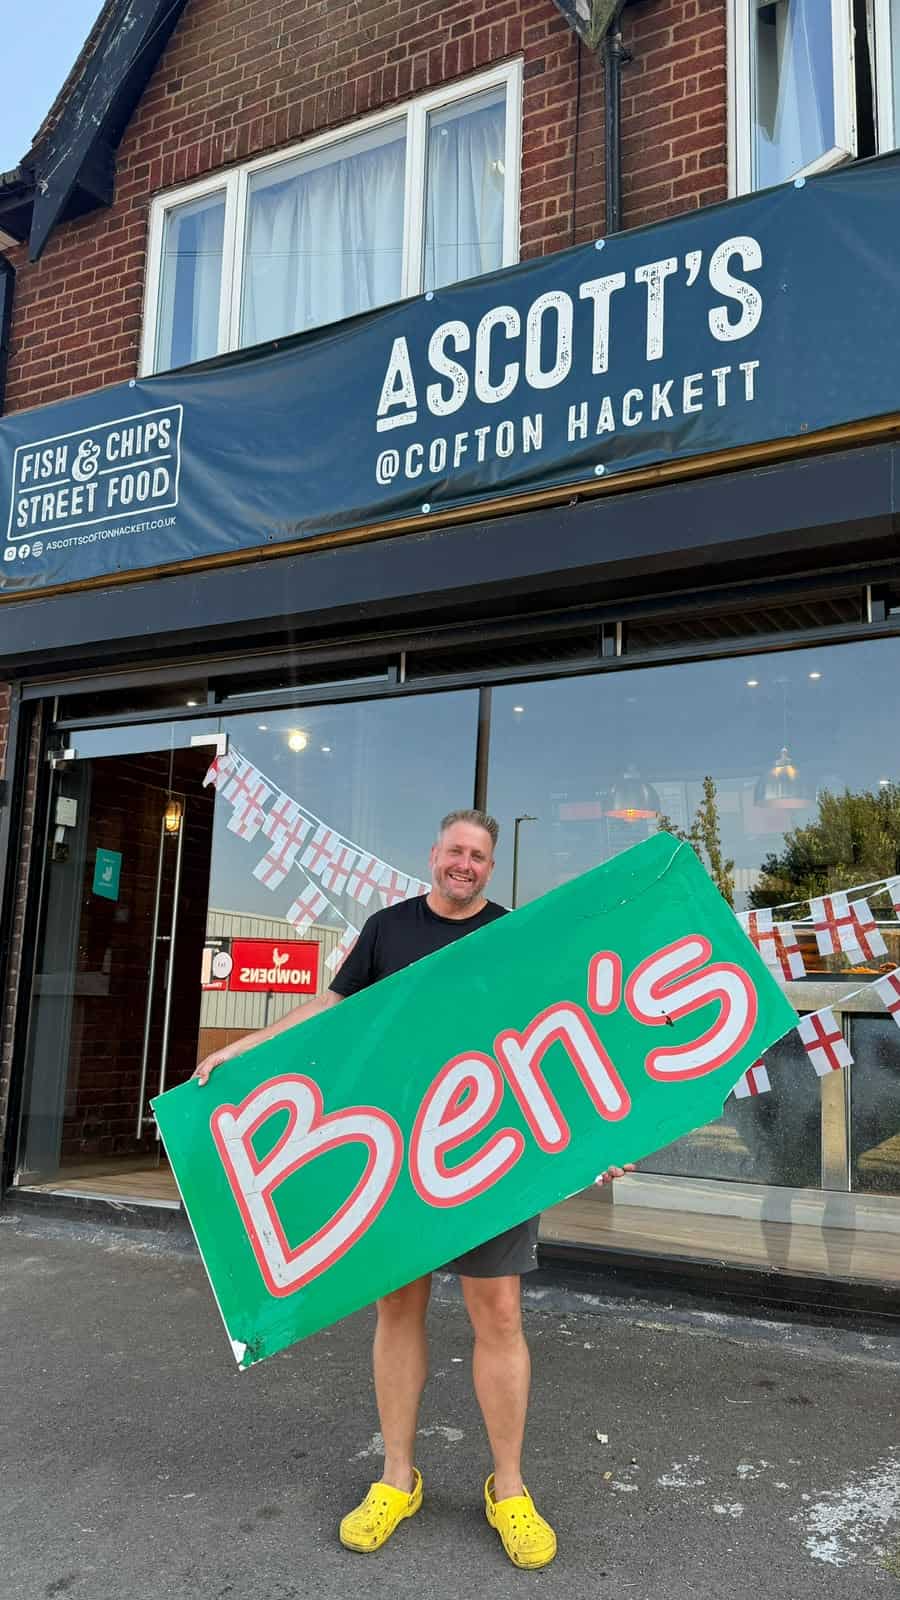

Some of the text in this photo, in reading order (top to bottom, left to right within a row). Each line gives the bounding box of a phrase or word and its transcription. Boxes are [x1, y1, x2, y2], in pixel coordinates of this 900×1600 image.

[376, 235, 763, 432] ASCOTT'S
[20, 418, 171, 483] FISH & CHIPS
[376, 360, 761, 484] @COFTON HACKETT
[16, 467, 170, 528] STREET FOOD
[46, 516, 177, 551] ASCOTTSCOFTONHACKETT.CO.UK
[210, 934, 758, 1298] Ben's
